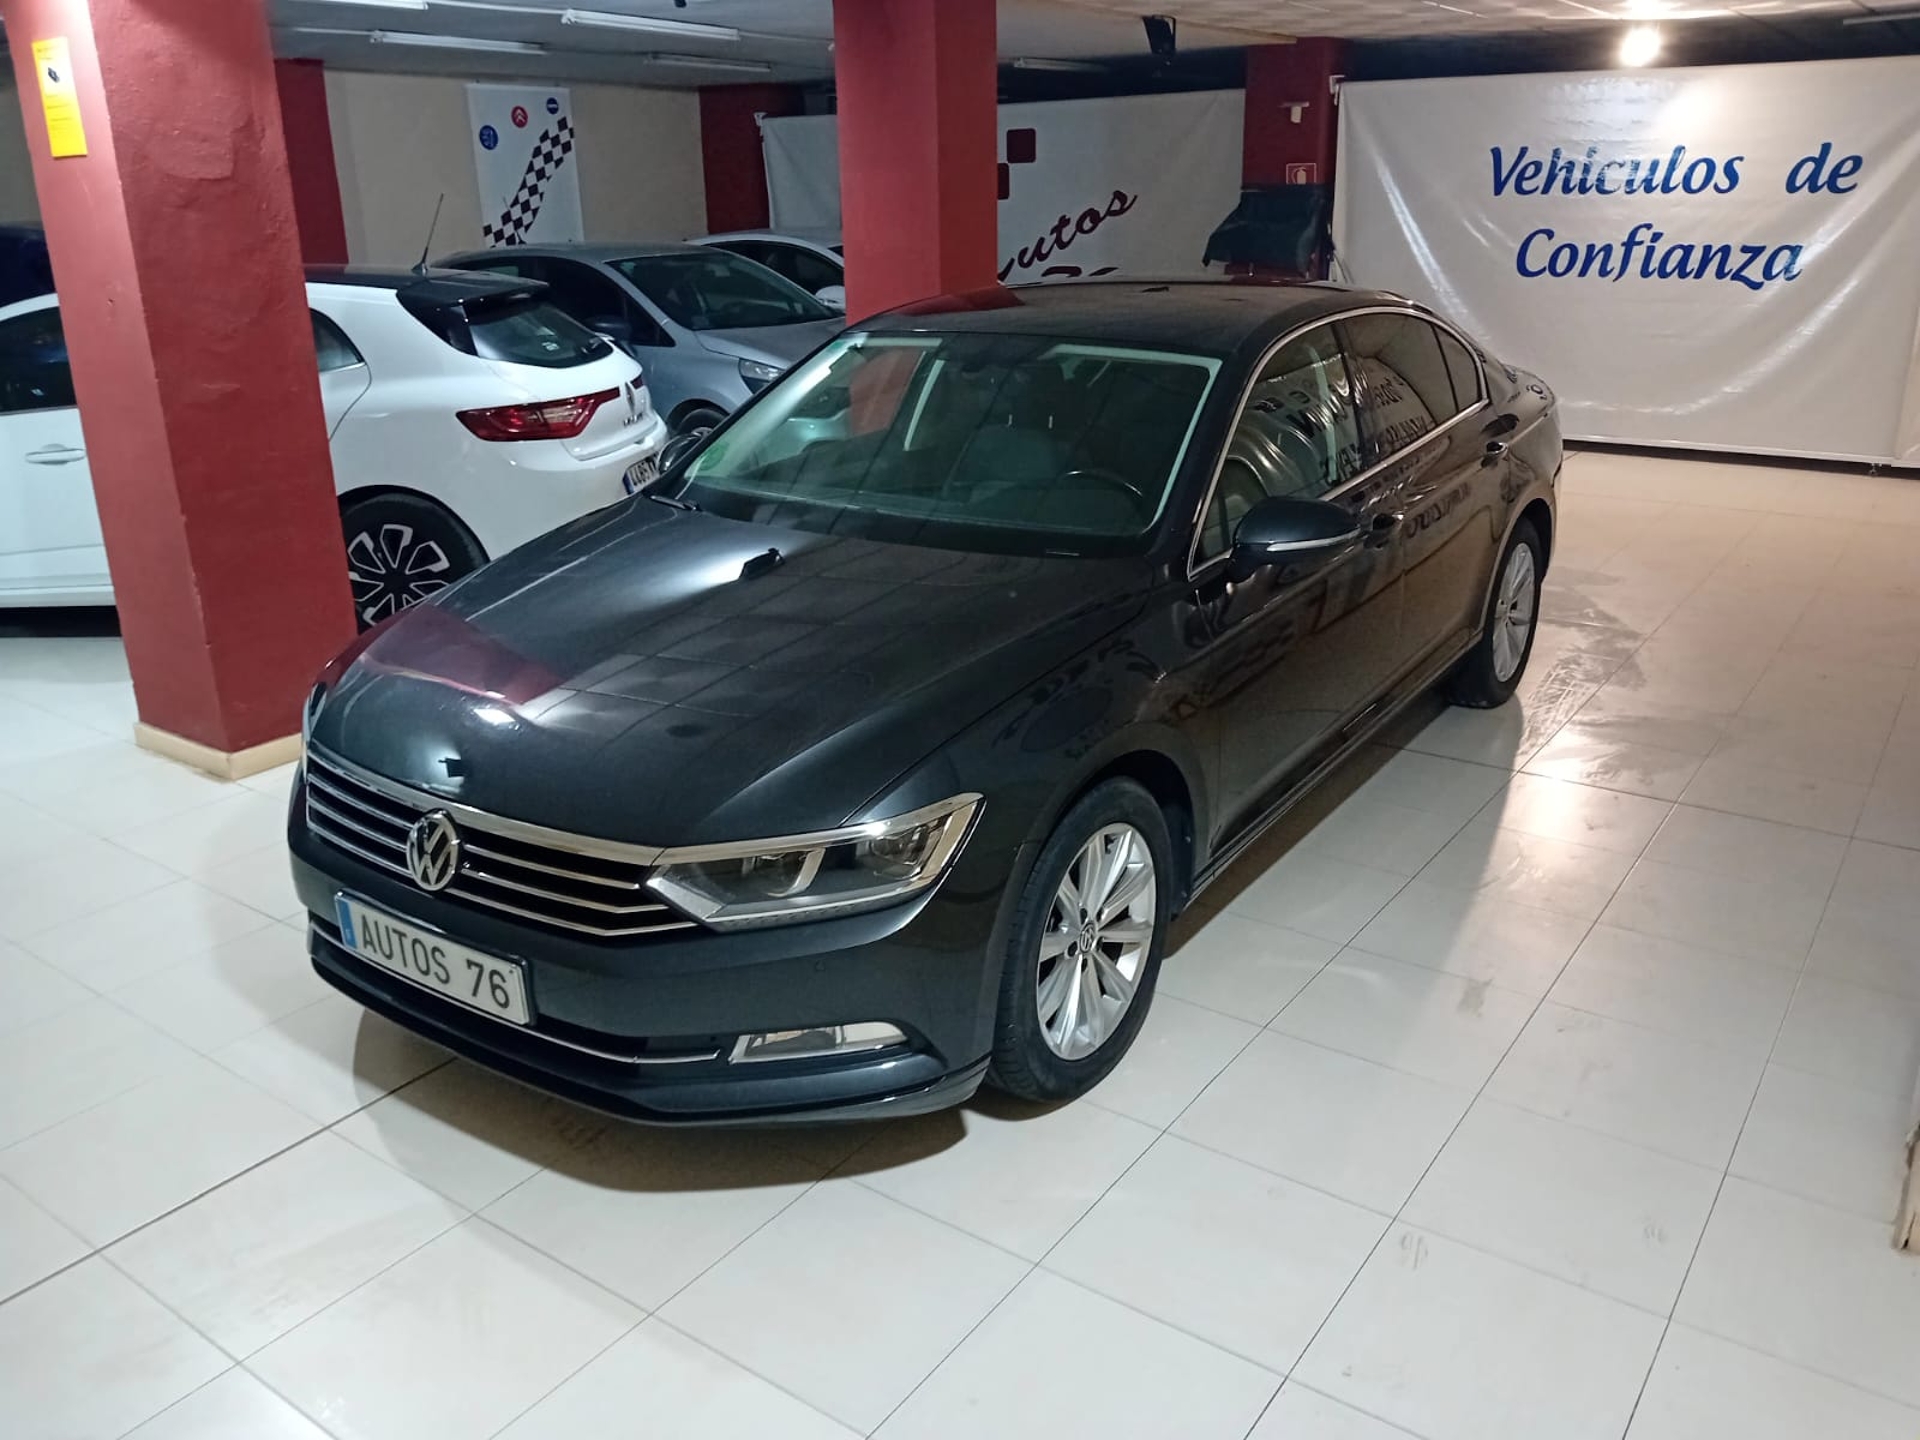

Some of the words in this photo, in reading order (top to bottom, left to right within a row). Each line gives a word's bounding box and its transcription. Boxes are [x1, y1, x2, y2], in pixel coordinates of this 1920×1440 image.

[1784, 141, 1864, 195] de
[998, 189, 1138, 282] utos
[1515, 222, 1804, 291] Confianza
[360, 913, 451, 985] AUTOS
[465, 957, 511, 1010] 76
